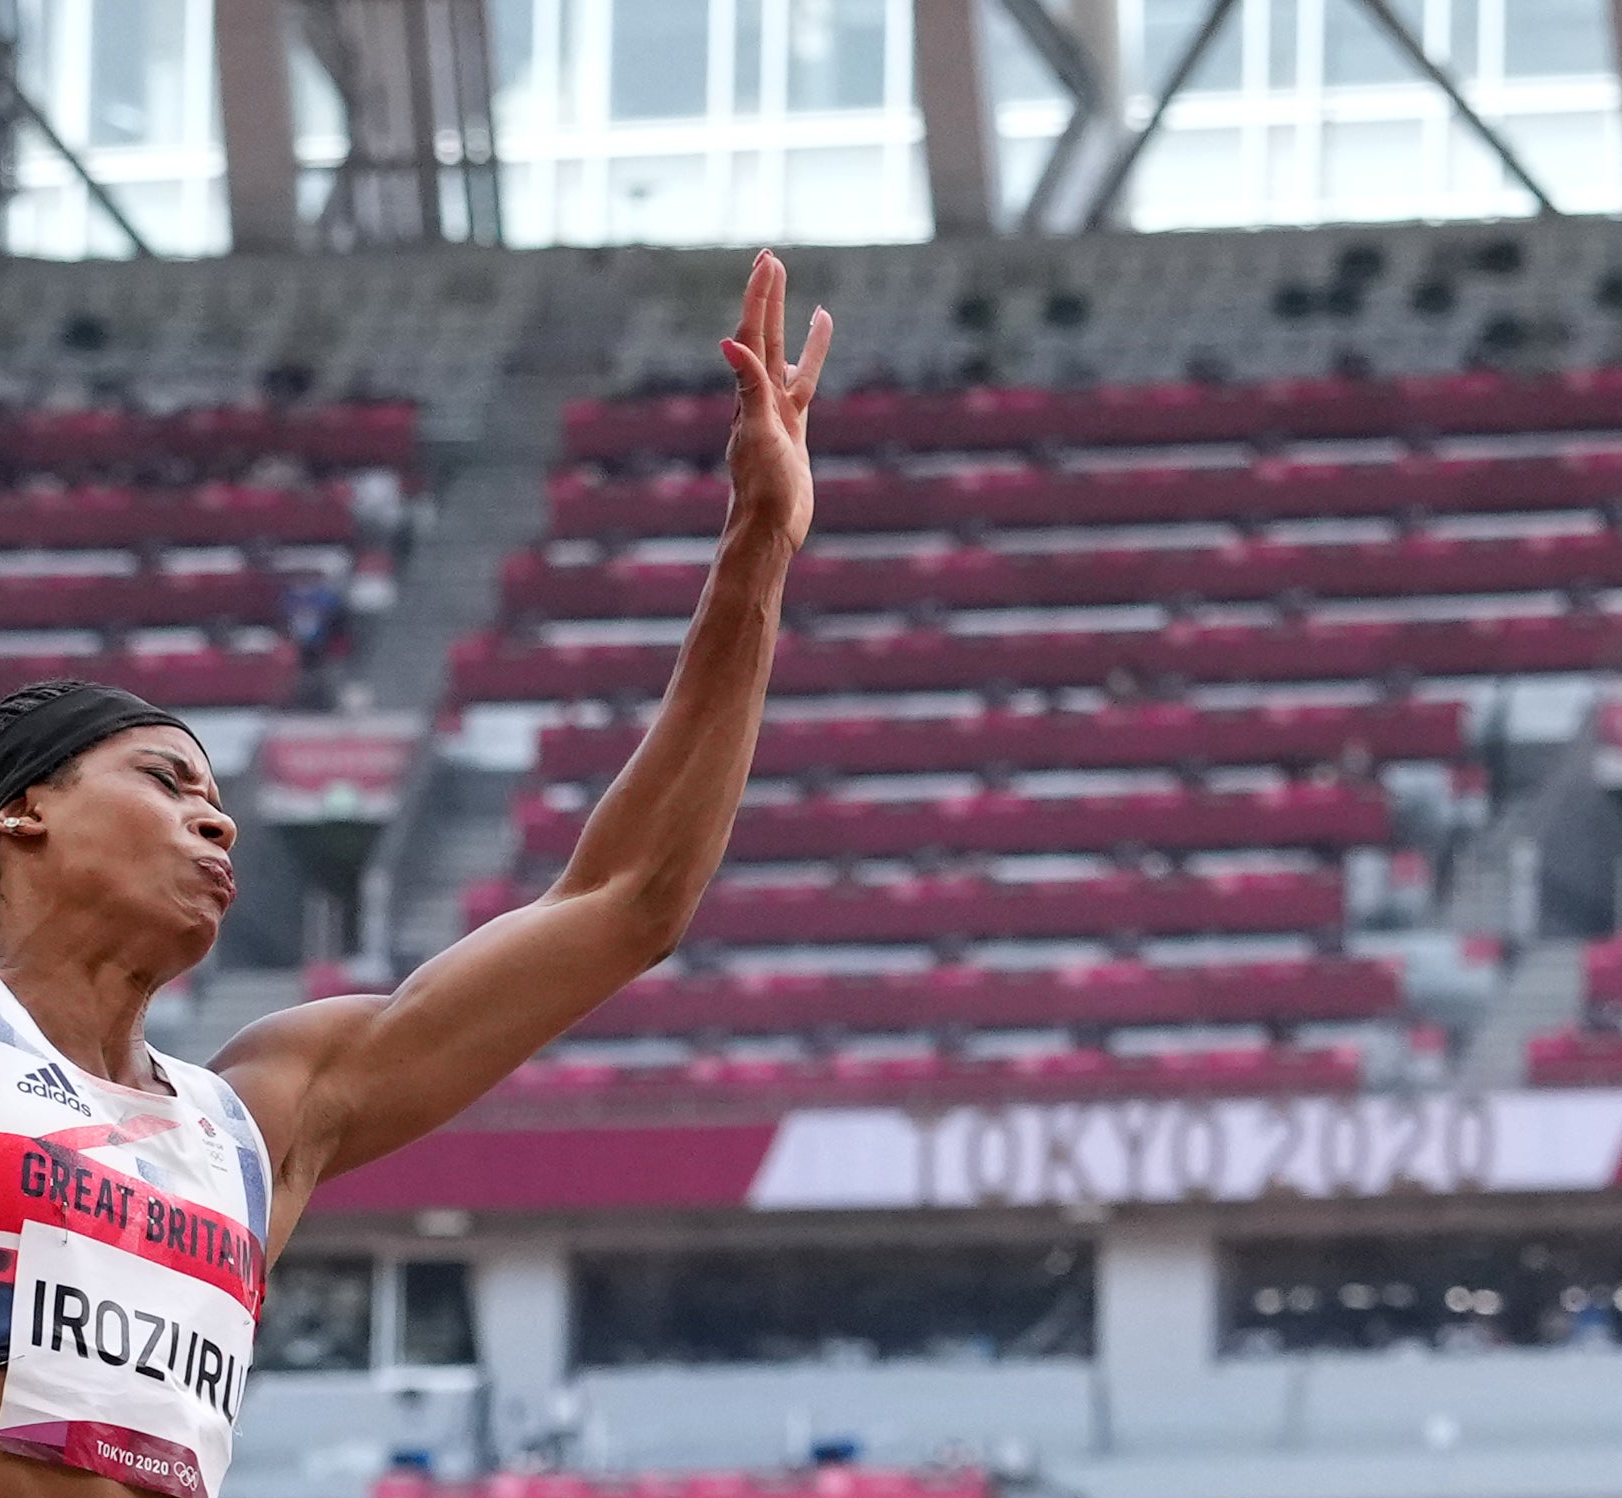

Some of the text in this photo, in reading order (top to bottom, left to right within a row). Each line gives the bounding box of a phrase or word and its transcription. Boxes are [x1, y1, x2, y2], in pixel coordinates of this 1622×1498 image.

[17, 1081, 92, 1117] adidas
[903, 1092, 1493, 1206] TOKYO 2020
[21, 1152, 135, 1229] GREAT
[97, 1440, 169, 1475] TOKYO 2020
